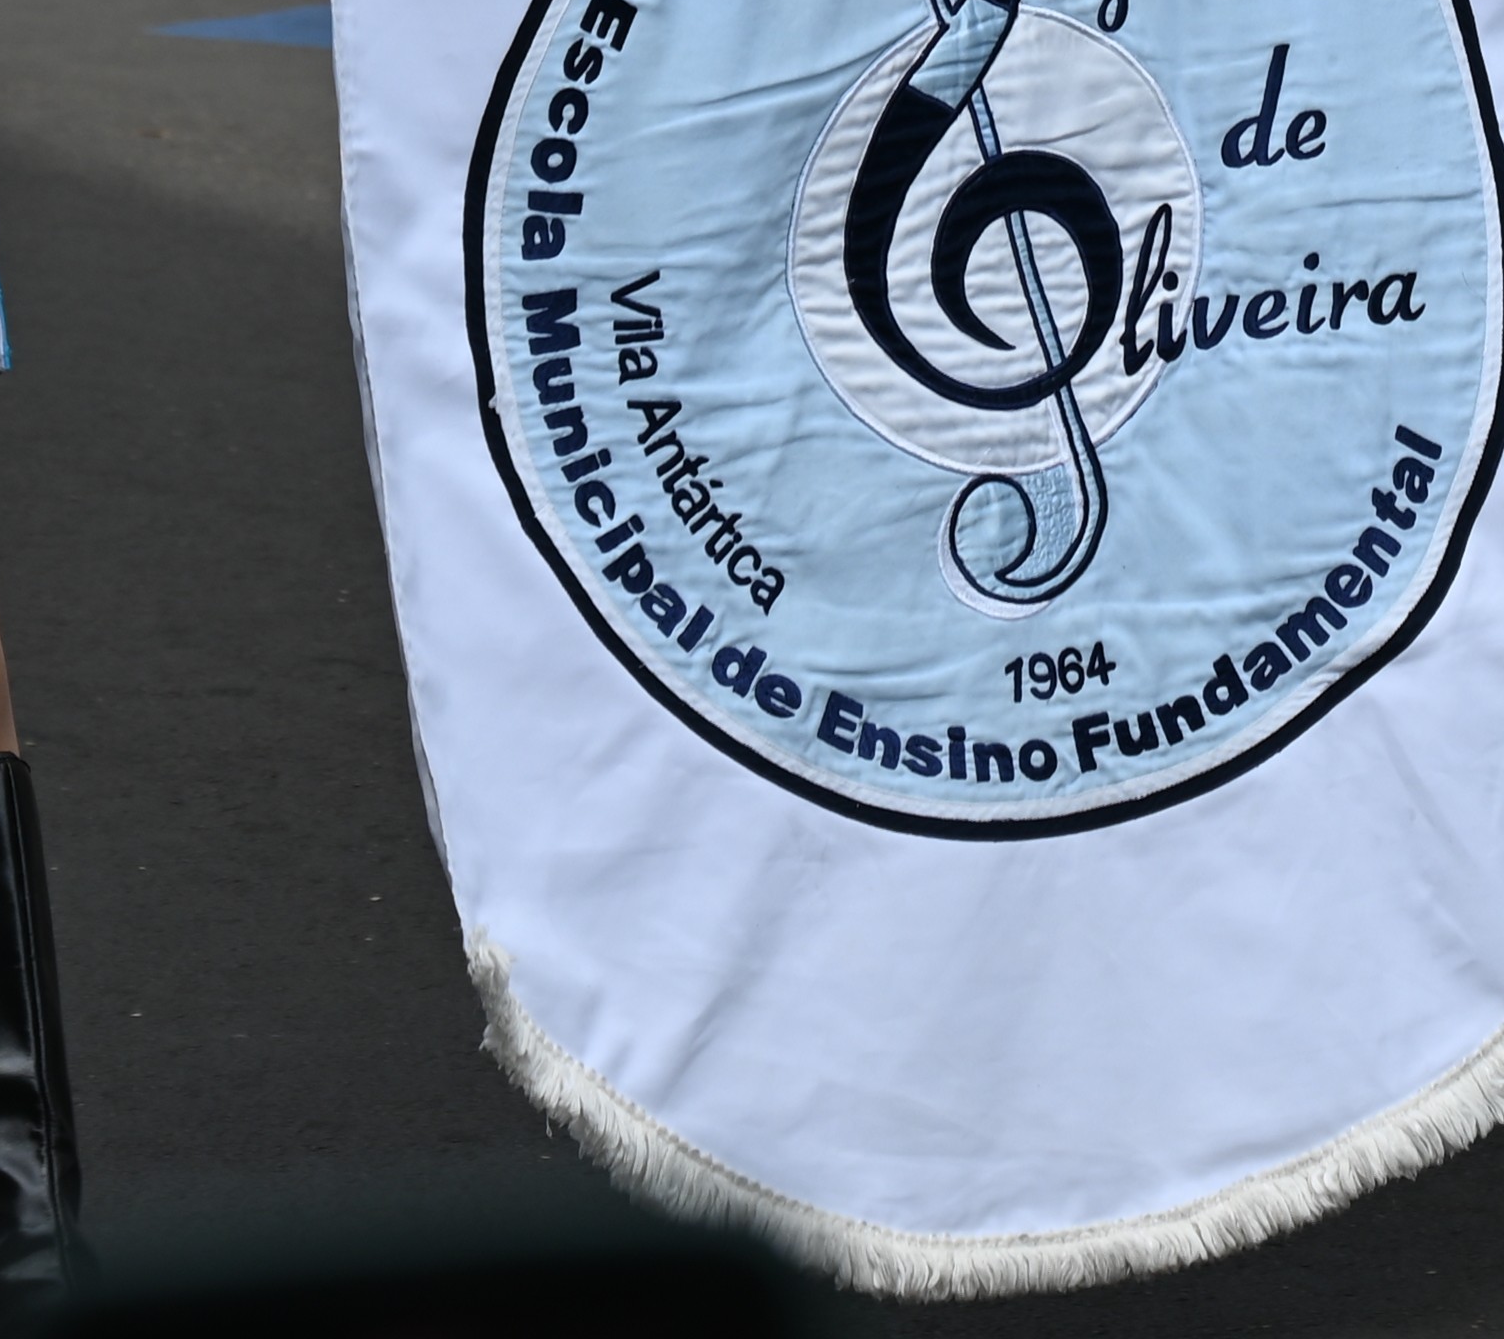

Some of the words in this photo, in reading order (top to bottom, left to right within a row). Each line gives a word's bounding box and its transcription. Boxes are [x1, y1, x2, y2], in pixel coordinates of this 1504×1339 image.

[1221, 44, 1327, 169] de
[610, 269, 665, 386] Vila
[521, 288, 715, 653] Municipal
[710, 645, 802, 719] de
[816, 690, 1058, 783] Ensino
[1071, 425, 1443, 774] Fundamental
[627, 399, 786, 617] Antártica
[1004, 641, 1117, 704] 1964
